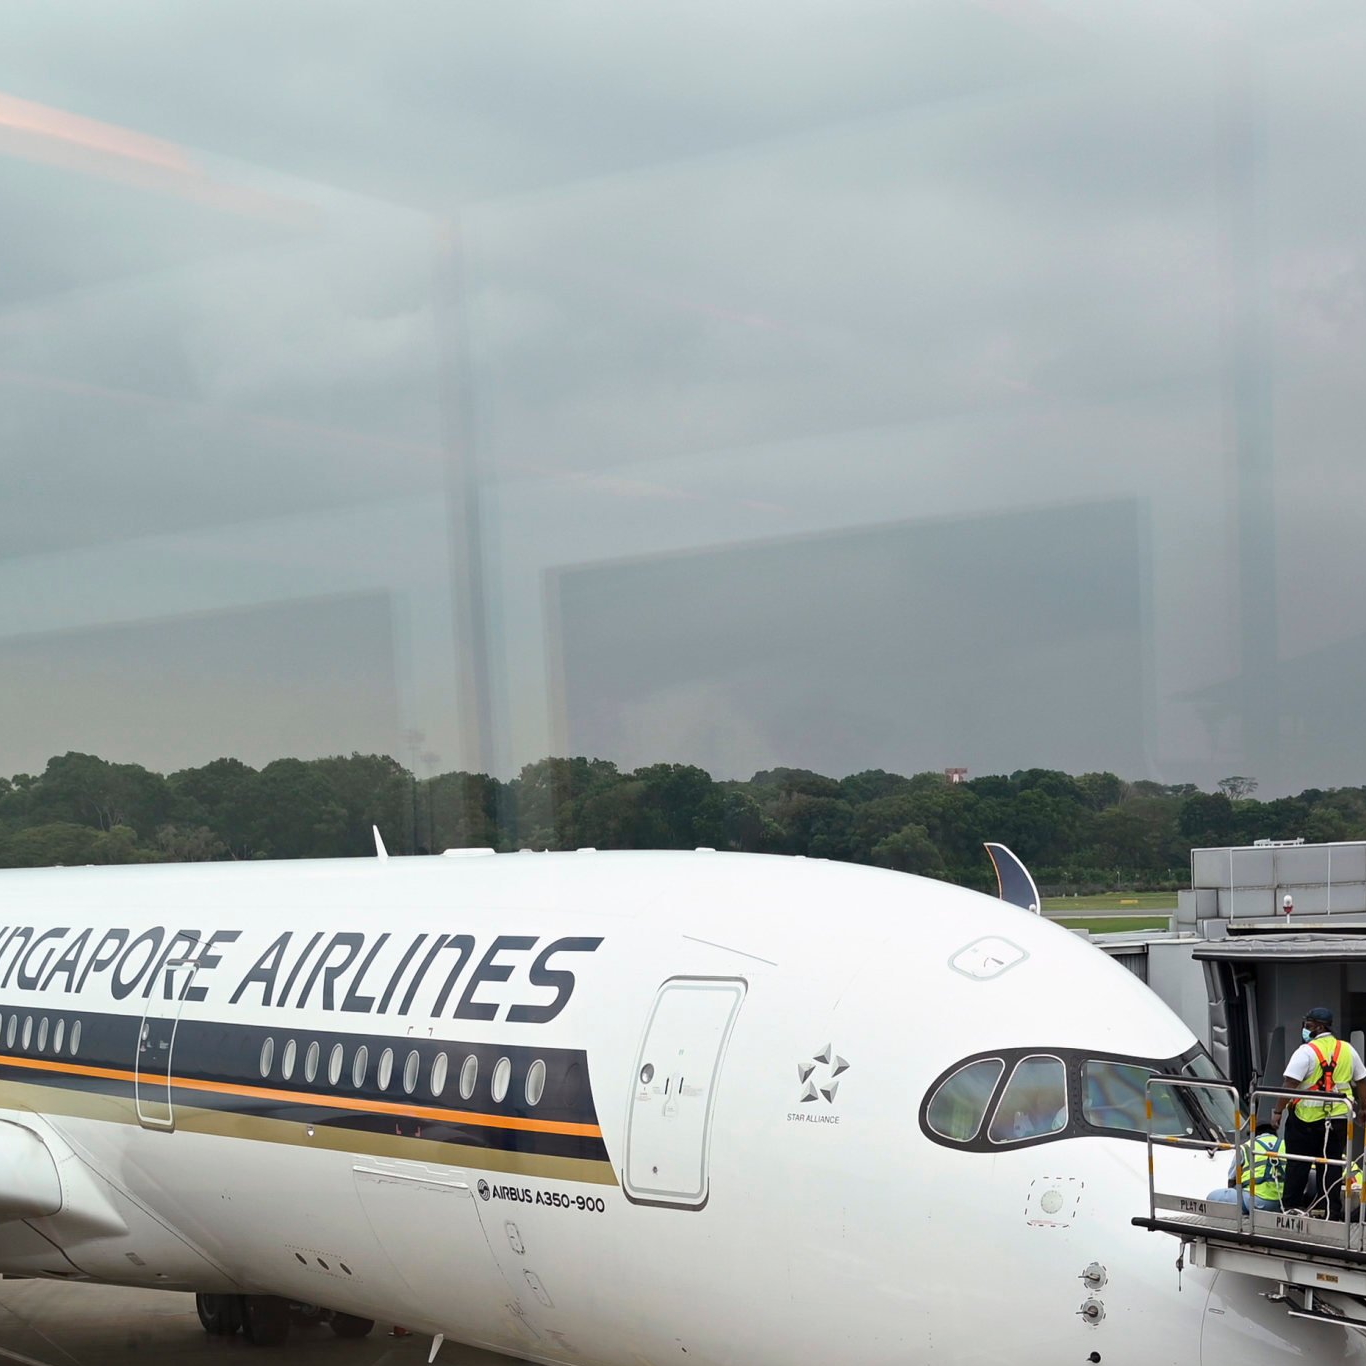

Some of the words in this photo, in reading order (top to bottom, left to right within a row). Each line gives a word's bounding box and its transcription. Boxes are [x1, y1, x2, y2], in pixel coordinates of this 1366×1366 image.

[229, 931, 605, 1024] AIRLINES
[787, 1112, 806, 1123] STAR
[806, 1114, 840, 1124] ALLIANCE
[492, 1184, 533, 1204] AIRBUS
[535, 1190, 606, 1213] A350-900
[1180, 1199, 1198, 1213] PLAT
[1198, 1202, 1207, 1214] 41
[1276, 1216, 1295, 1230] PLAT
